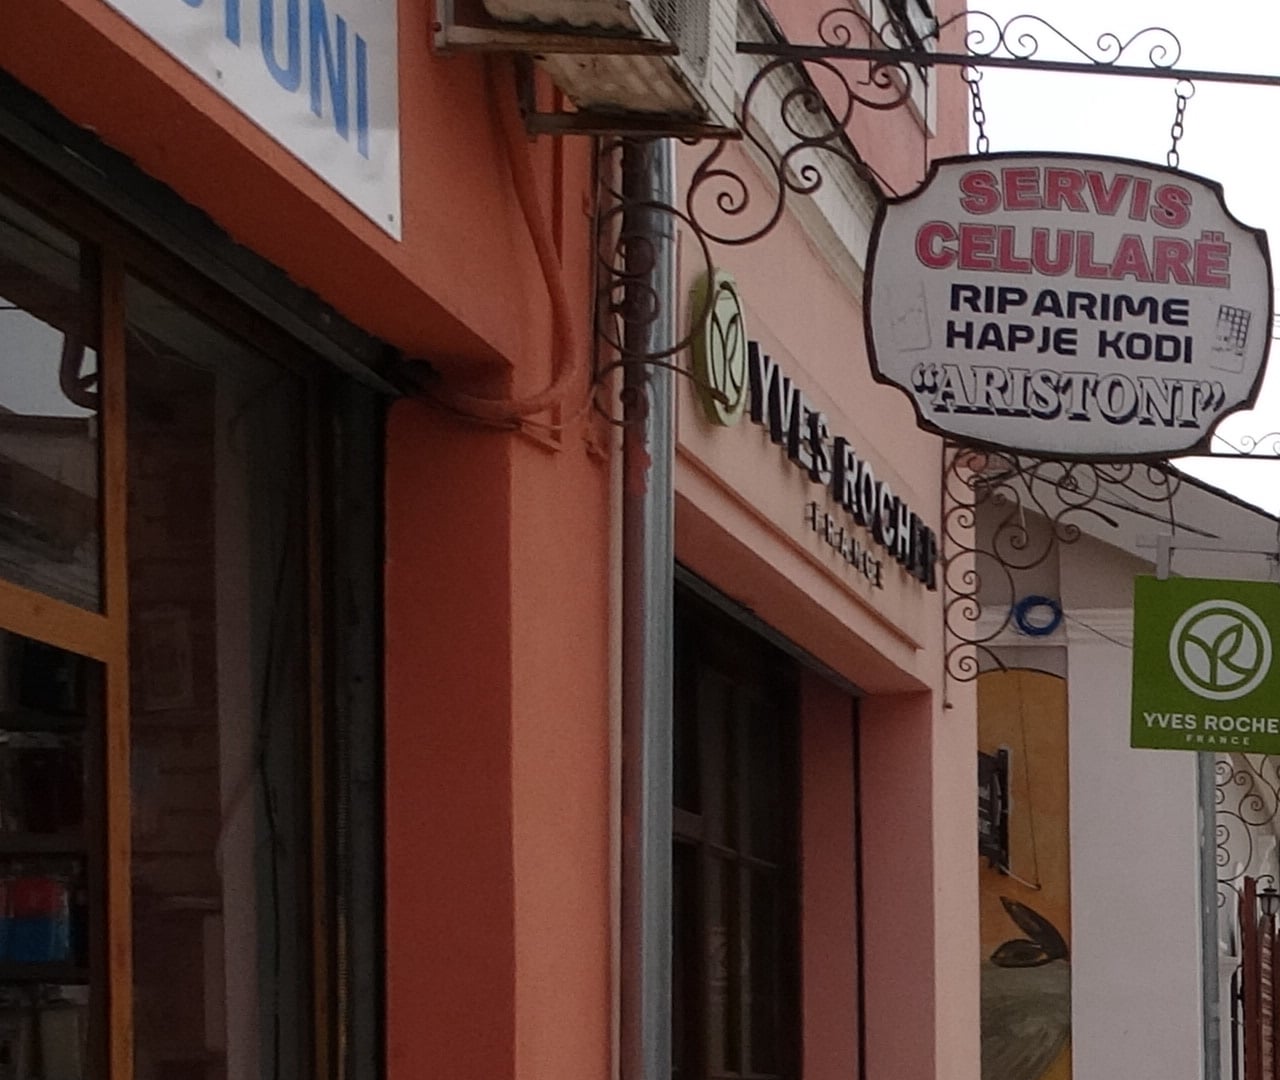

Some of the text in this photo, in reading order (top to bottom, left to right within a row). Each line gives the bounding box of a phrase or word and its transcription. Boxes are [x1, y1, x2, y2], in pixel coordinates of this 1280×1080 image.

[958, 165, 1193, 229] SERVIS
[914, 219, 1232, 289] CELULARË
[950, 283, 1190, 327] RIPARIME
[945, 320, 1193, 364] HAPJE KODI
[747, 340, 833, 486] YVES
[1143, 712, 1197, 729] YVES
[1186, 735, 1250, 746] FRANCE
